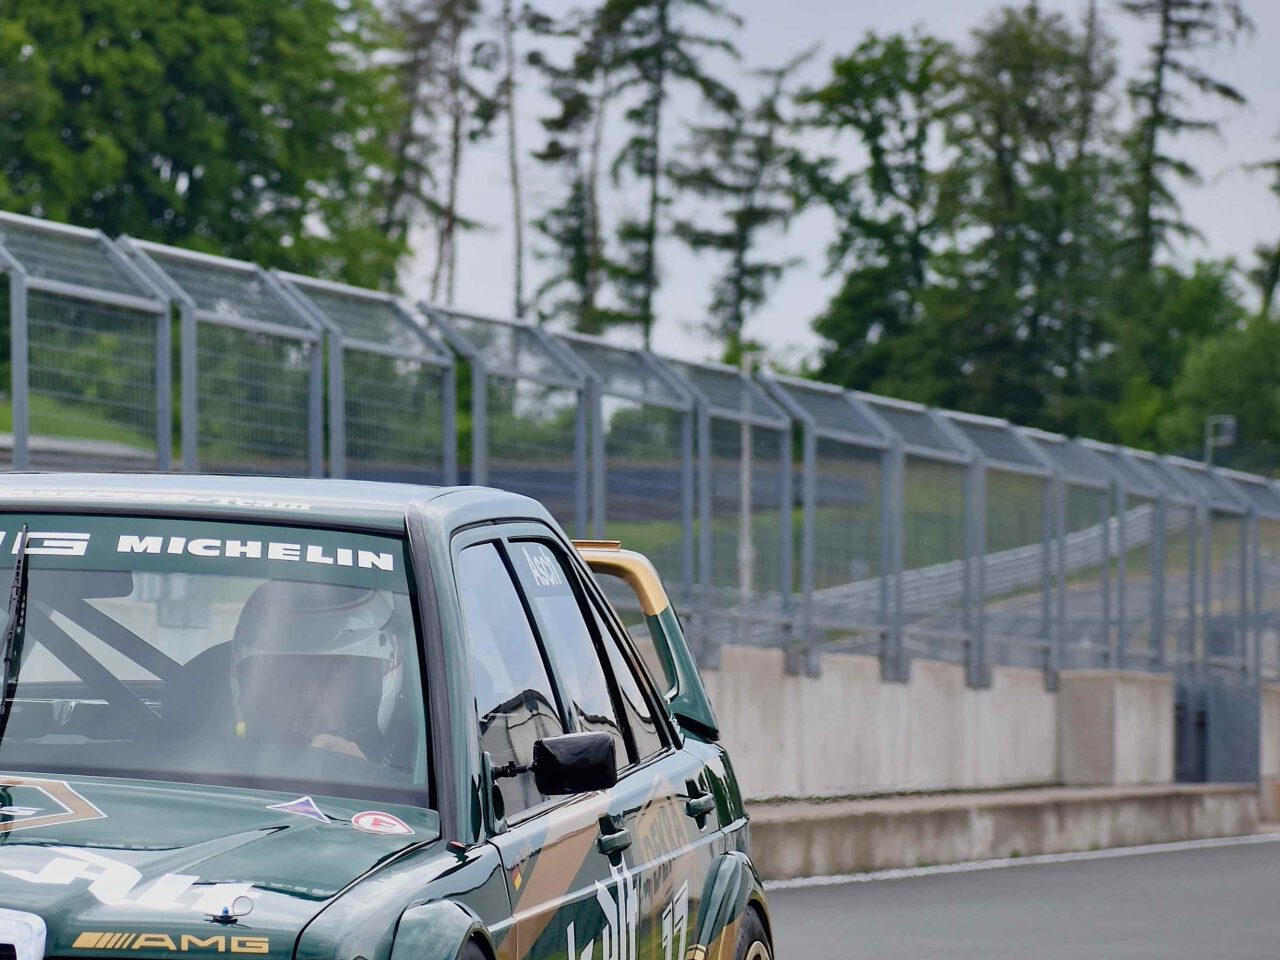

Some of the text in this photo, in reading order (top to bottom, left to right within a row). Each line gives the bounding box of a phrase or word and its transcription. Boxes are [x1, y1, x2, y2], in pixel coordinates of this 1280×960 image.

[117, 534, 395, 571] MICHELIN
[522, 546, 563, 588] Asch
[131, 933, 270, 953] AMG
